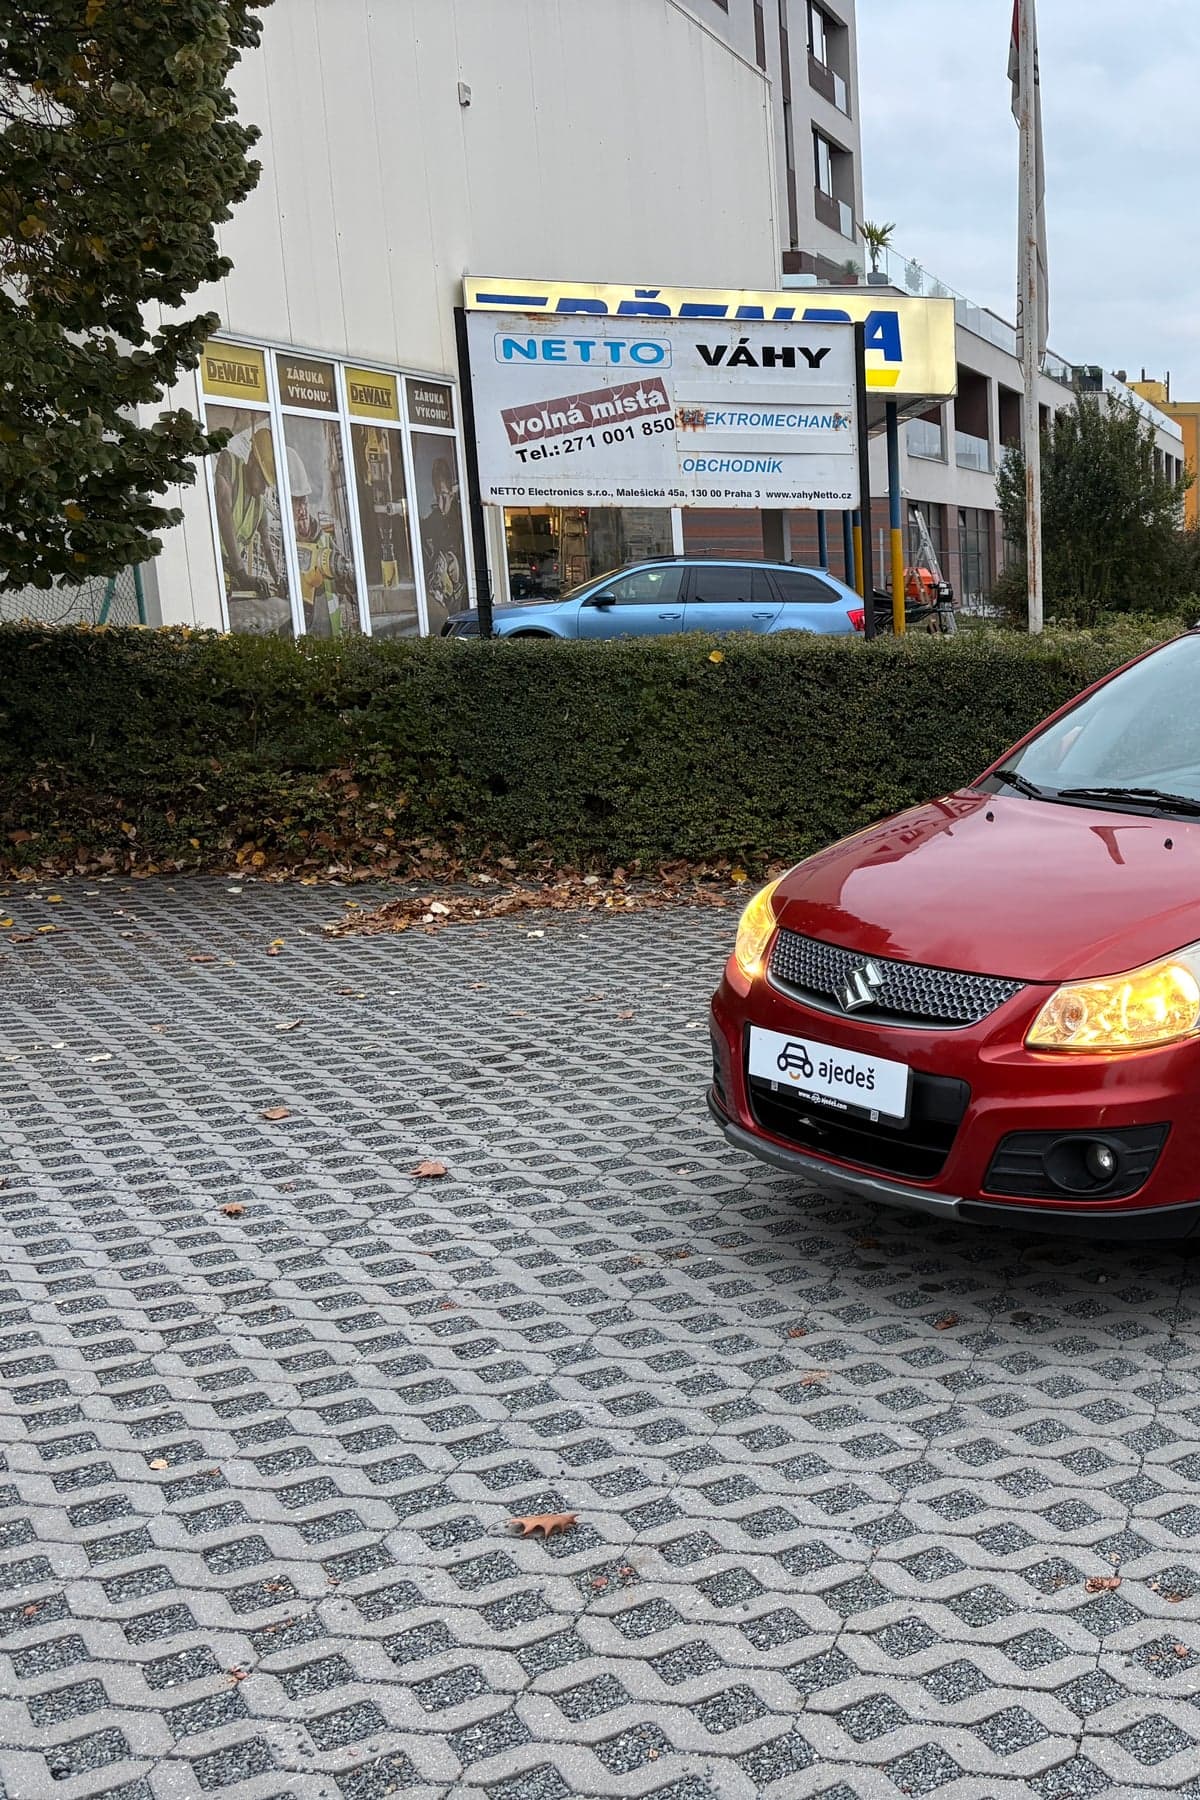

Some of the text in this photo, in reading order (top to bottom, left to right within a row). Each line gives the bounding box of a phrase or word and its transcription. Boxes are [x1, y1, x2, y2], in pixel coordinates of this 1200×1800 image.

[502, 338, 665, 365] NETTO
[695, 337, 832, 369] VÁHY
[286, 365, 324, 385] ZÁRUKA
[414, 388, 444, 405] ZÁRUKA
[510, 386, 666, 436] volná místa
[562, 434, 597, 454] 271
[602, 425, 635, 445] 001
[641, 417, 675, 436] 850
[682, 457, 784, 473] OBCHODNÍK
[490, 487, 526, 496] NETTO
[528, 487, 584, 497] Electronics
[616, 487, 666, 497] Malešická
[667, 488, 688, 498] 45a,
[690, 489, 708, 497] 130
[710, 489, 722, 498] 00
[724, 490, 752, 498] Praha
[754, 490, 761, 498] 3
[766, 490, 852, 501] www.vahyNetto.cz
[818, 1058, 876, 1091] ajedeš
